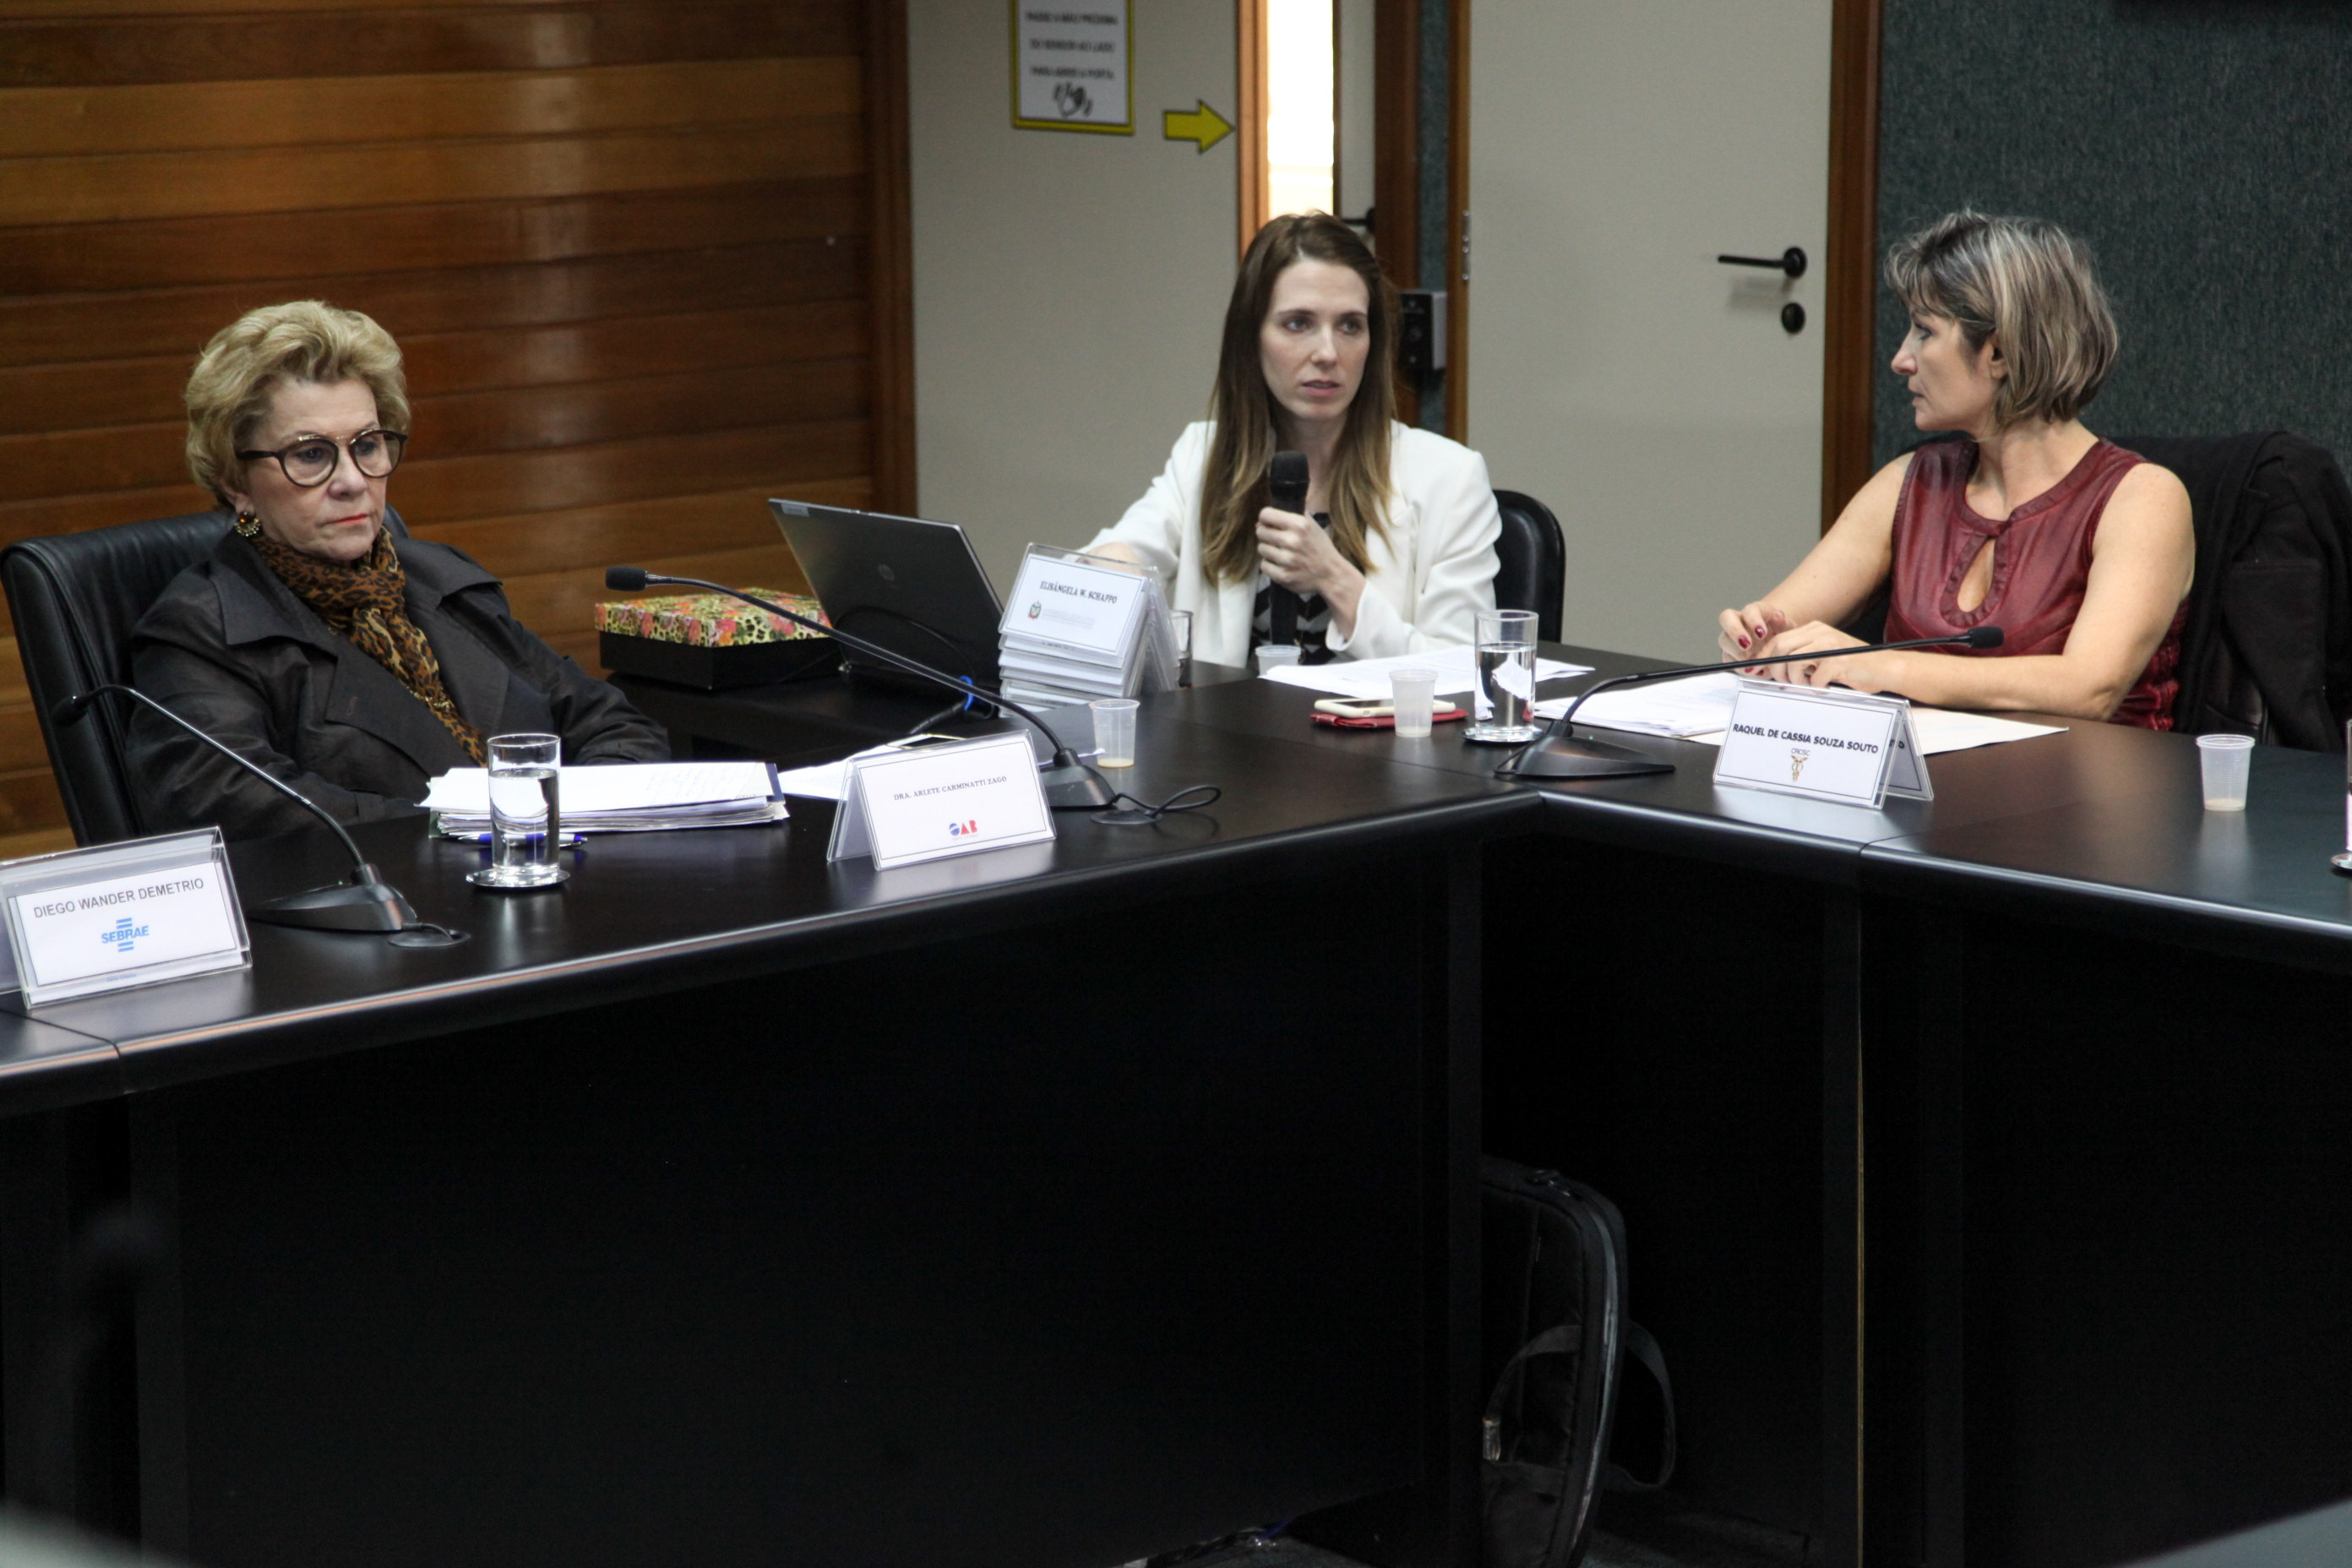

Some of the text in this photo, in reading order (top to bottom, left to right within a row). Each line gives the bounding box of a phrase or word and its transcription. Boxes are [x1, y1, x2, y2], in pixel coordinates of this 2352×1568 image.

[1039, 580, 1078, 596] ELISÂNGELA
[1080, 590, 1086, 598] W.
[1732, 723, 1765, 737] RAQUEL
[1767, 728, 1779, 738] DE
[1781, 731, 1811, 743] CASSIA
[1813, 736, 1845, 749] SOUZA
[1847, 740, 1879, 754] SOUTO
[893, 776, 1007, 801] DRA. ARLETE CARMINATTI ZAGO
[949, 819, 977, 836] OAB
[34, 878, 204, 918] DIEGO WANDER DEMETRIO
[101, 925, 150, 945] SEBRAE
